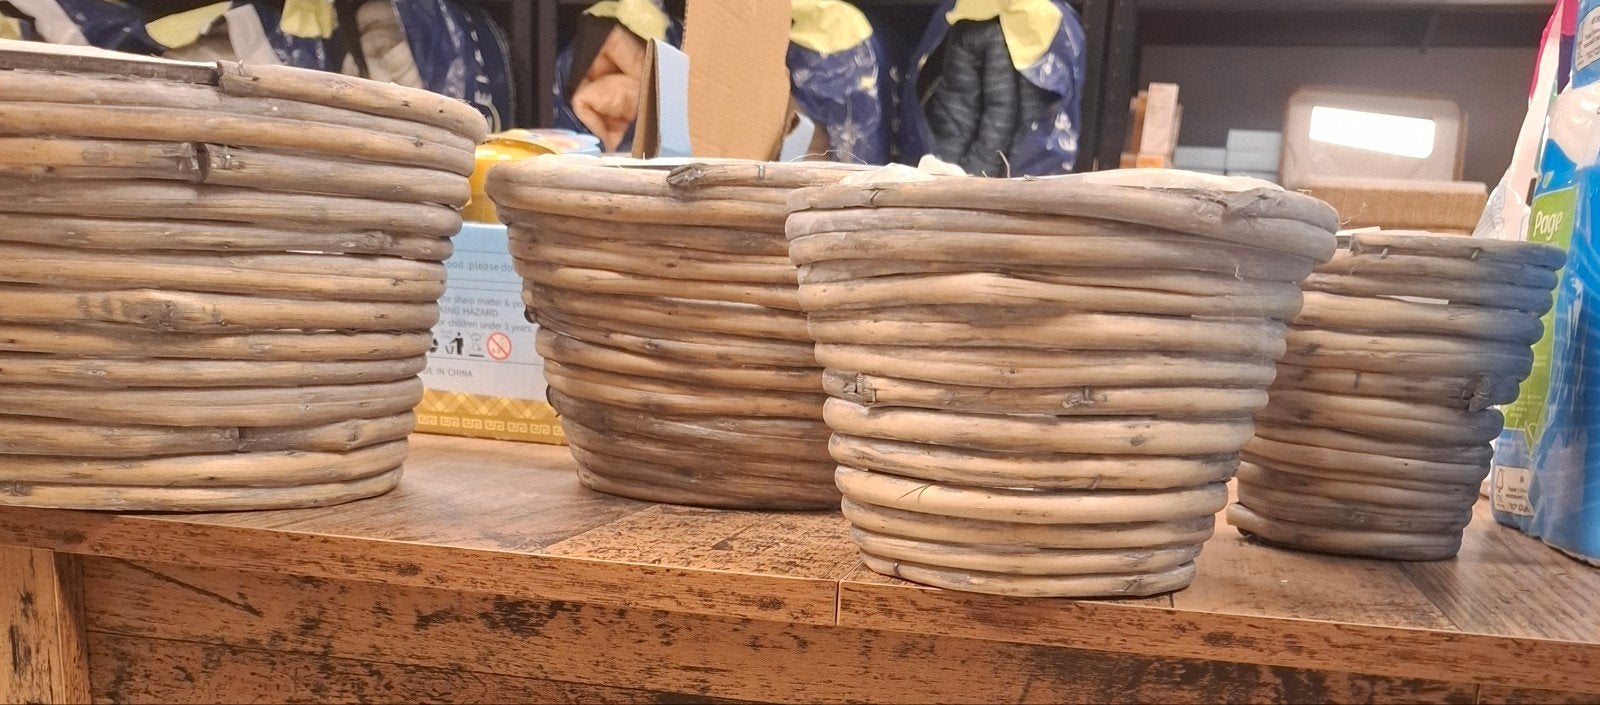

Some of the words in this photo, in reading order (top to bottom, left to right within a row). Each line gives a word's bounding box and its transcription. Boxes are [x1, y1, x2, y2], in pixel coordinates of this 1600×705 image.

[1533, 210, 1563, 241] Page
[446, 259, 464, 269] ood
[477, 298, 502, 307] matter
[463, 307, 499, 317] HAZARD
[448, 320, 479, 329] children
[480, 321, 502, 330] under
[436, 367, 445, 376] IN
[447, 368, 473, 377] CHINA
